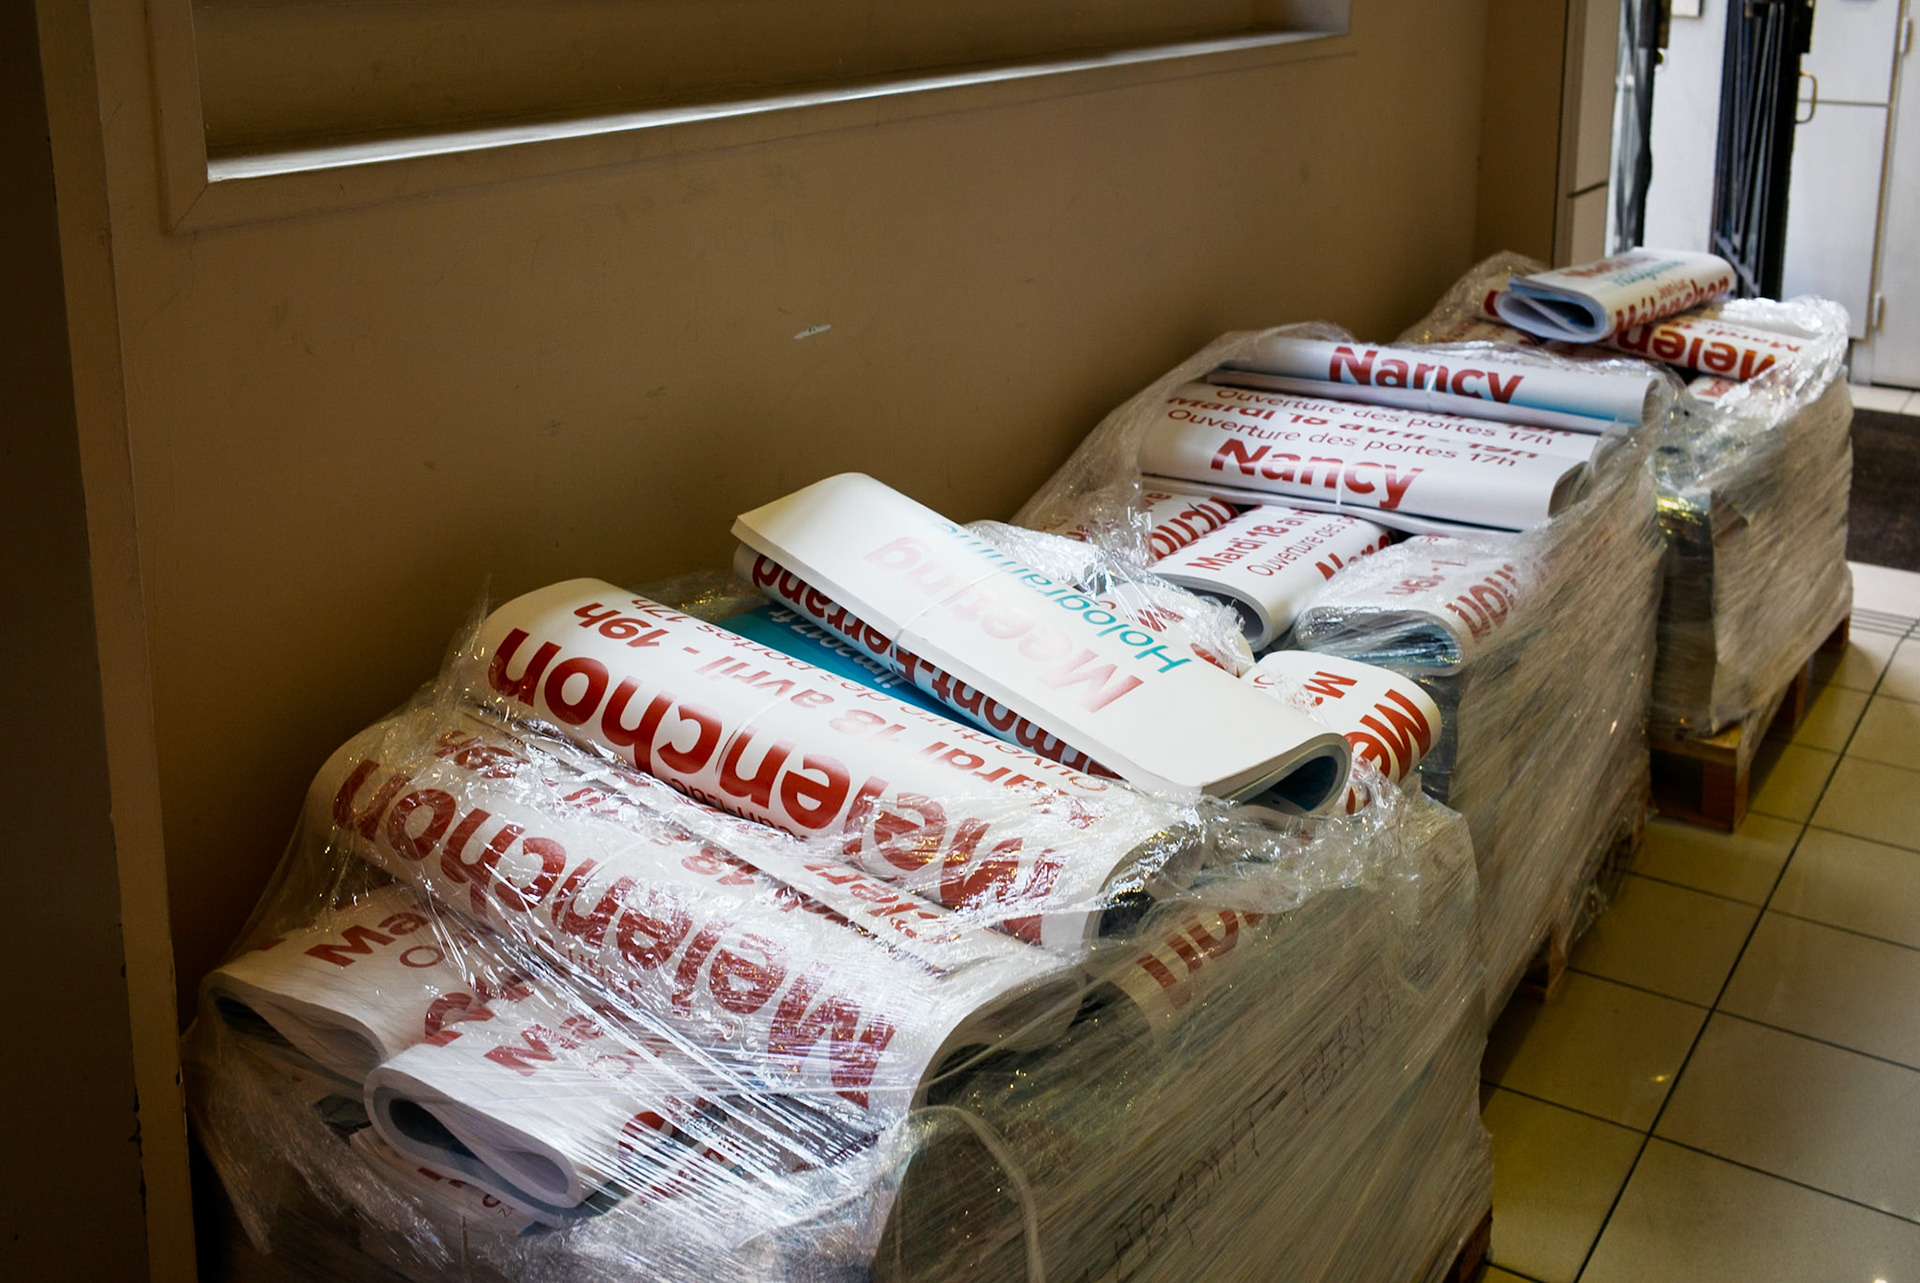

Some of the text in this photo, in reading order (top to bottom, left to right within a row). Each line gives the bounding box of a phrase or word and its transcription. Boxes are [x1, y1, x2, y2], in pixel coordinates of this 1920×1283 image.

[1167, 408, 1517, 467] Ouverture des portes 17h
[1216, 386, 1345, 414] Ouverture
[1352, 408, 1400, 423] des
[1406, 417, 1497, 438] portes
[1508, 431, 1553, 446] 17h
[1209, 437, 1425, 509] Nancy
[1185, 531, 1267, 571] Mardi
[1246, 517, 1290, 544] 18
[1246, 535, 1325, 577] Ouverture
[573, 602, 670, 648] 19h
[631, 598, 684, 624] 17h
[862, 536, 1145, 714] Meeting
[694, 655, 836, 709] avril
[828, 708, 907, 744] 18
